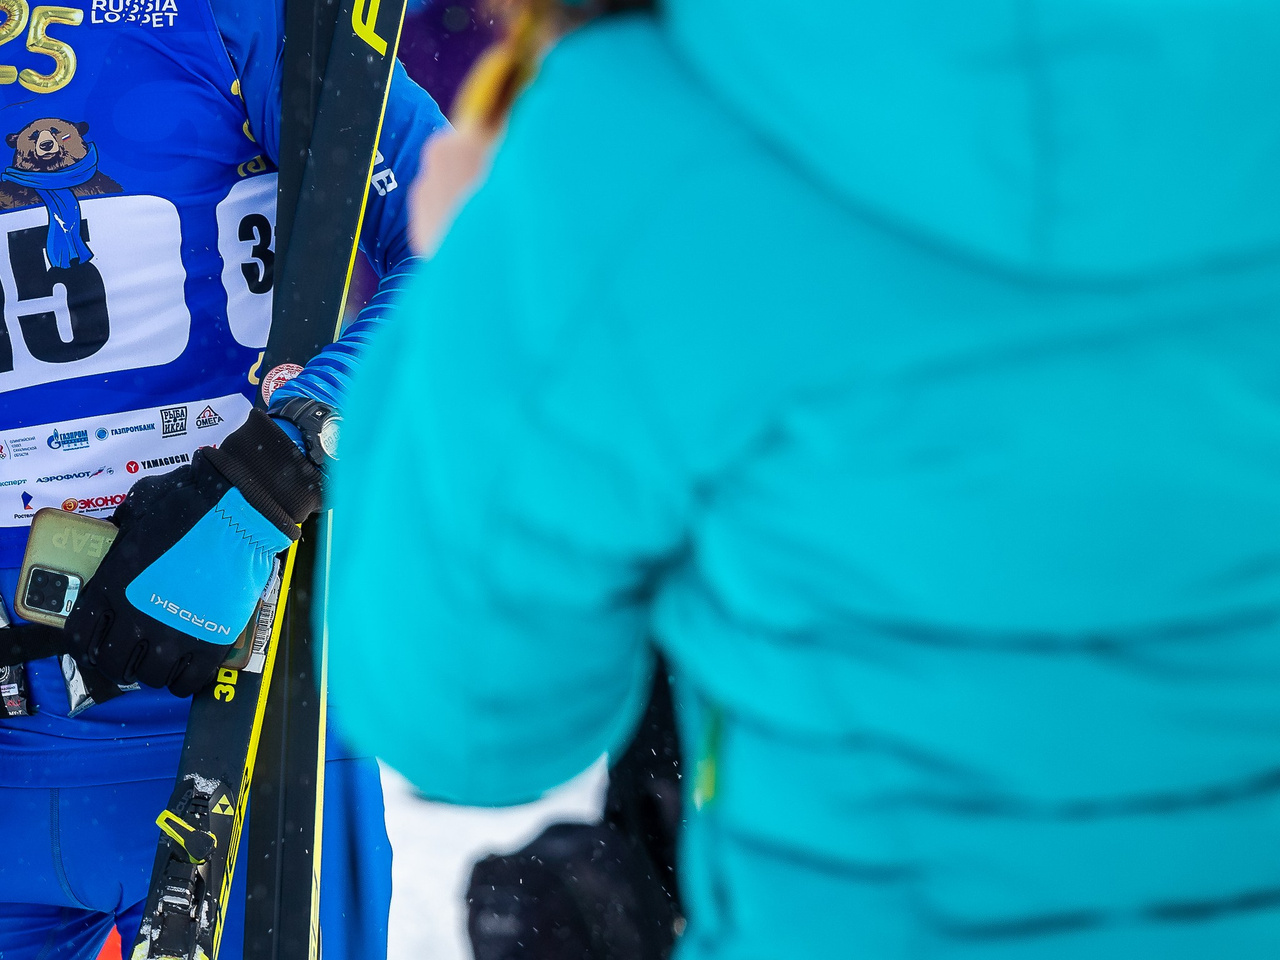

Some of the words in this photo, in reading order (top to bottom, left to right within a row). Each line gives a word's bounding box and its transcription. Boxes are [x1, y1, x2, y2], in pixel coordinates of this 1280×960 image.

[238, 213, 276, 295] 3
[164, 409, 185, 420] РЫБА
[164, 422, 185, 433] ИКРА
[196, 416, 224, 427] ОМЕГА
[60, 430, 88, 441] ГАЗПРОМ
[111, 423, 155, 436] ГАЗПРОМБАНК
[141, 453, 190, 470] YAMAGUCHI
[36, 471, 91, 483] АЭРОФЛОТ
[150, 593, 232, 636] NORDSKI
[214, 667, 238, 702] 3D
